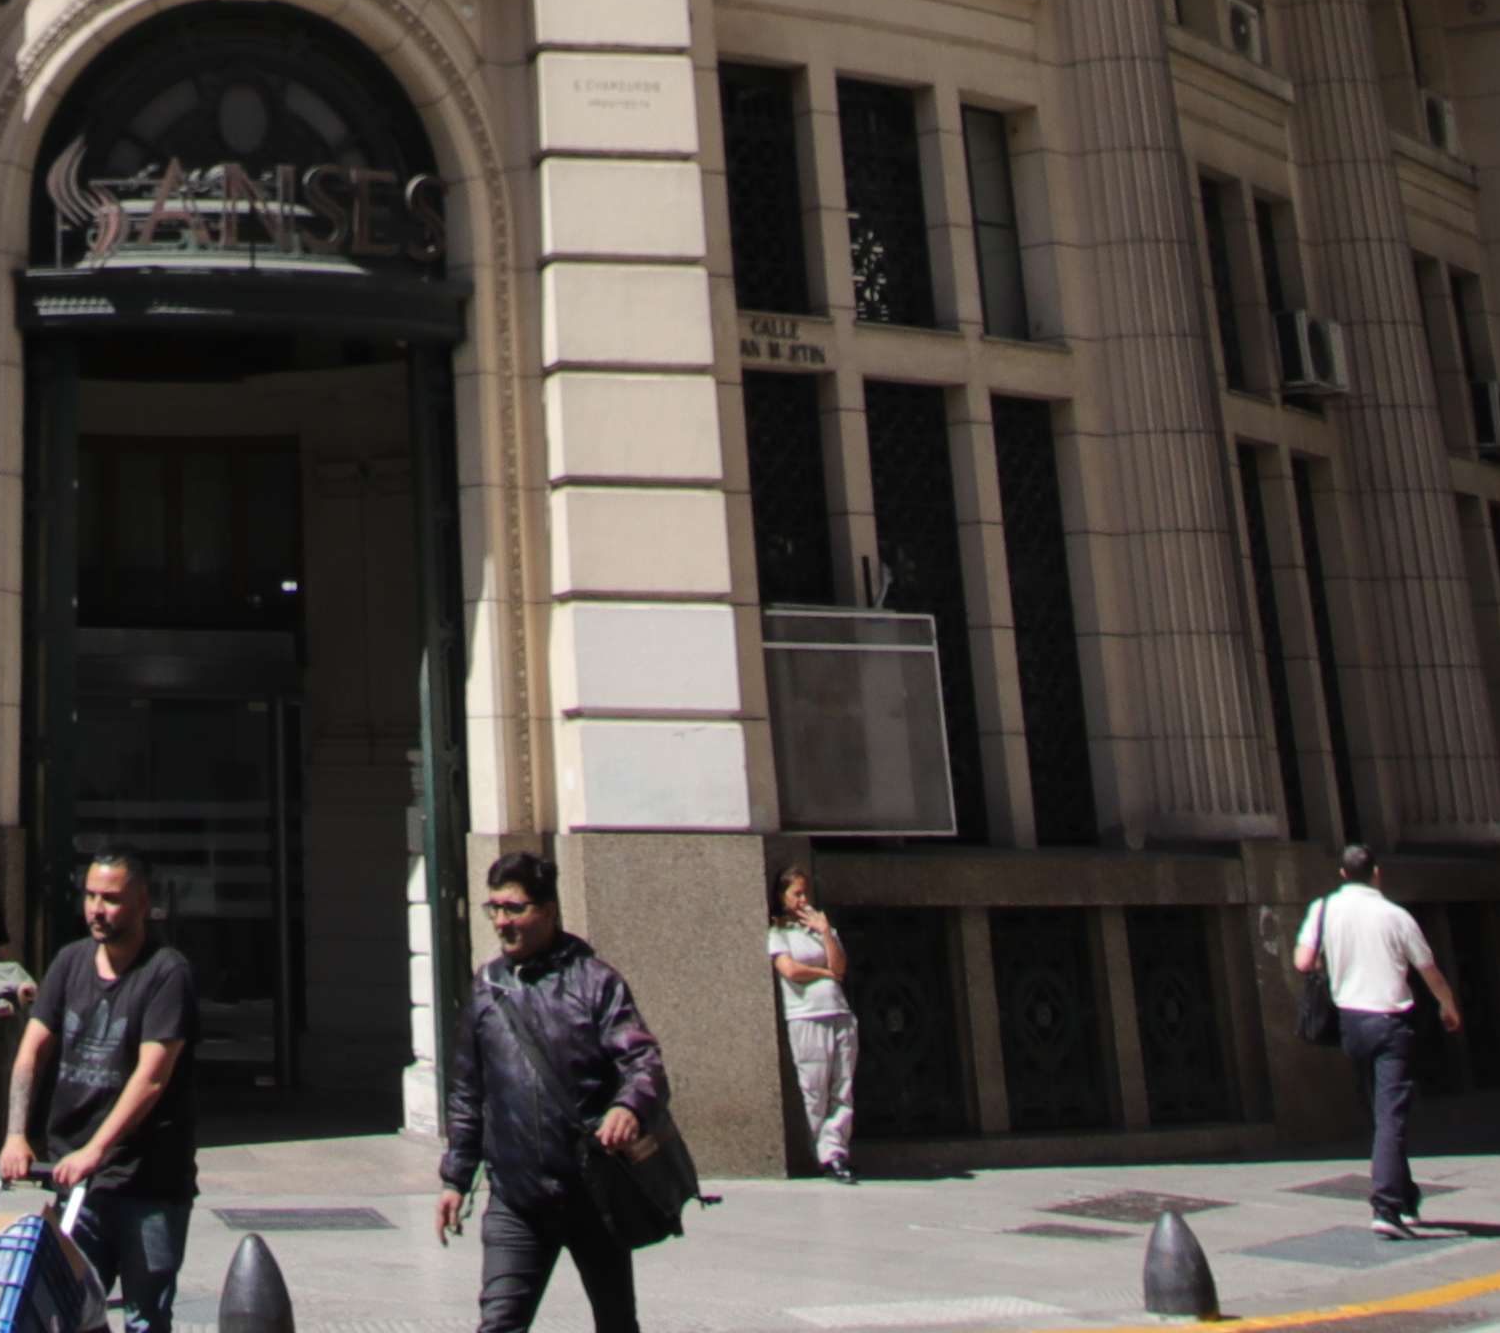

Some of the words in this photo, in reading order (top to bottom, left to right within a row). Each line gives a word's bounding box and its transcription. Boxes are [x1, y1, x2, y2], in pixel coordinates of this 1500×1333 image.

[137, 155, 451, 263] ANSES
[749, 317, 801, 341] CALLE
[767, 341, 827, 364] MRTIN
